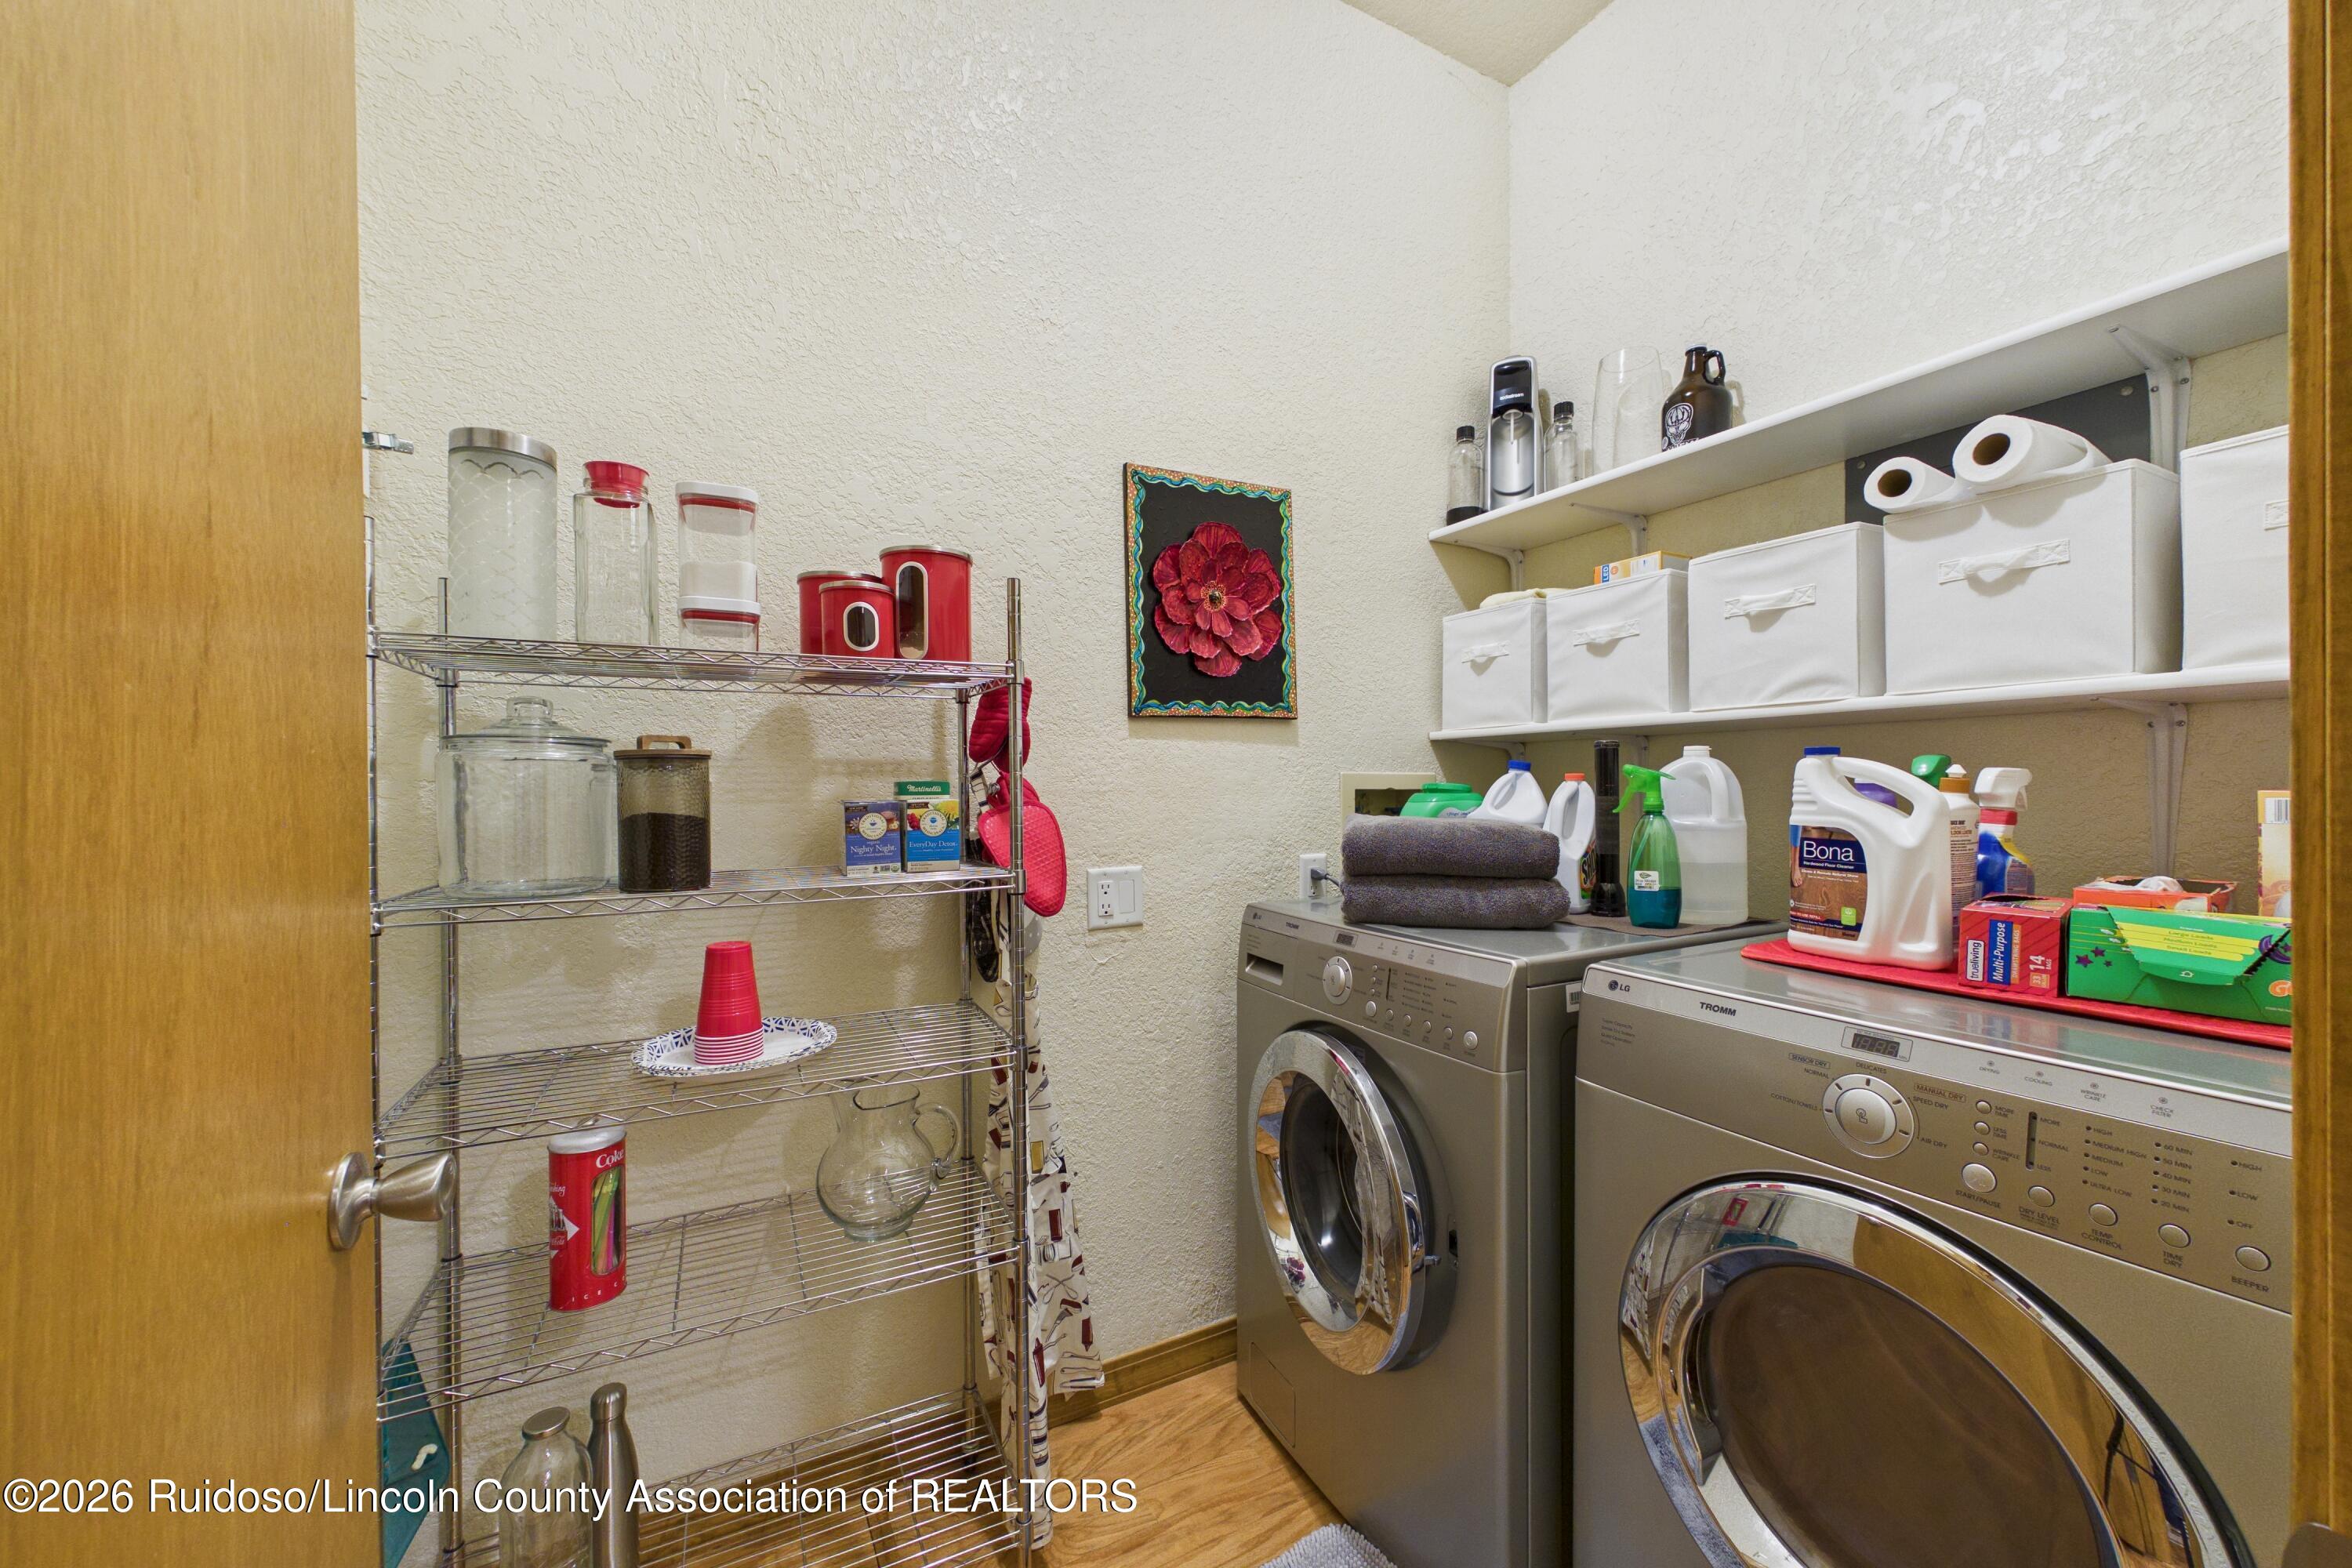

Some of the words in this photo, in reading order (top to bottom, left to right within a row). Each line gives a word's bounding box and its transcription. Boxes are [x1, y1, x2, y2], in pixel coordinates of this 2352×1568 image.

[850, 846, 874, 855] Nighty
[1803, 840, 1855, 862] Bona
[2169, 930, 2187, 938] Large
[2189, 932, 2214, 941] Loads
[2163, 937, 2194, 946] Medium
[2194, 941, 2218, 949] Loads
[1992, 922, 2008, 982] Multi-Purpose
[2166, 945, 2187, 953] Small
[2188, 947, 2212, 956] Loads
[1970, 942, 1982, 978] trueliving
[2029, 955, 2045, 971] 14
[2032, 975, 2042, 985] 33
[1619, 983, 1631, 993] LG
[1700, 1001, 1737, 1017] TROMM
[1791, 1054, 1813, 1064] SENSOR
[1856, 1062, 1887, 1074] DELICATES
[1979, 1066, 2000, 1075] DRYING
[1804, 1068, 1829, 1080] NORMAL
[2024, 1076, 2053, 1087] COOLING
[1916, 1084, 1947, 1098] MANUAL
[1948, 1092, 1964, 1101] DRY
[2080, 1088, 2107, 1098] WRINKLE
[1770, 1092, 1818, 1111] COTTON/TOWELS
[1913, 1096, 1933, 1106] SPEED
[1934, 1102, 1948, 1110] DRY
[1994, 1105, 2014, 1114] MORE
[2150, 1104, 2174, 1113] CHECK
[2151, 1109, 2172, 1118] FILTER
[2040, 1116, 2061, 1127] MORE
[2092, 1127, 2113, 1136] HIGH
[1921, 1137, 1933, 1145] AIR
[1933, 1140, 1947, 1149] DRY
[2038, 1139, 2069, 1152] NORMAL
[1993, 1149, 2020, 1160] WRINKLE
[2092, 1140, 2125, 1154] MEDIUM
[2126, 1149, 2147, 1159] HIGH
[2176, 1147, 2193, 1156] MIN
[596, 1149, 624, 1168] Coke
[2091, 1154, 2124, 1167] MEDIUM
[2037, 1163, 2052, 1172] LESS
[2175, 1161, 2192, 1170] MIN
[2238, 1162, 2263, 1171] HIGH
[2090, 1167, 2108, 1177] LOW
[2173, 1175, 2191, 1185] MIN
[2089, 1181, 2111, 1192] ULTRA
[2114, 1189, 2132, 1197] LOW
[2172, 1189, 2190, 1199] MIN
[1955, 1189, 2002, 1209] START/PAUSE
[2237, 1192, 2259, 1201] LOW
[2172, 1203, 2190, 1213] MIN
[2019, 1206, 2034, 1216] DRY
[2037, 1211, 2060, 1225] LEVEL
[2081, 1232, 2122, 1250] CONTROL
[2163, 1250, 2183, 1261] TIME
[2163, 1258, 2183, 1268] DRY
[2231, 1276, 2270, 1293] BEEPER
[572, 1289, 602, 1302] ICE
